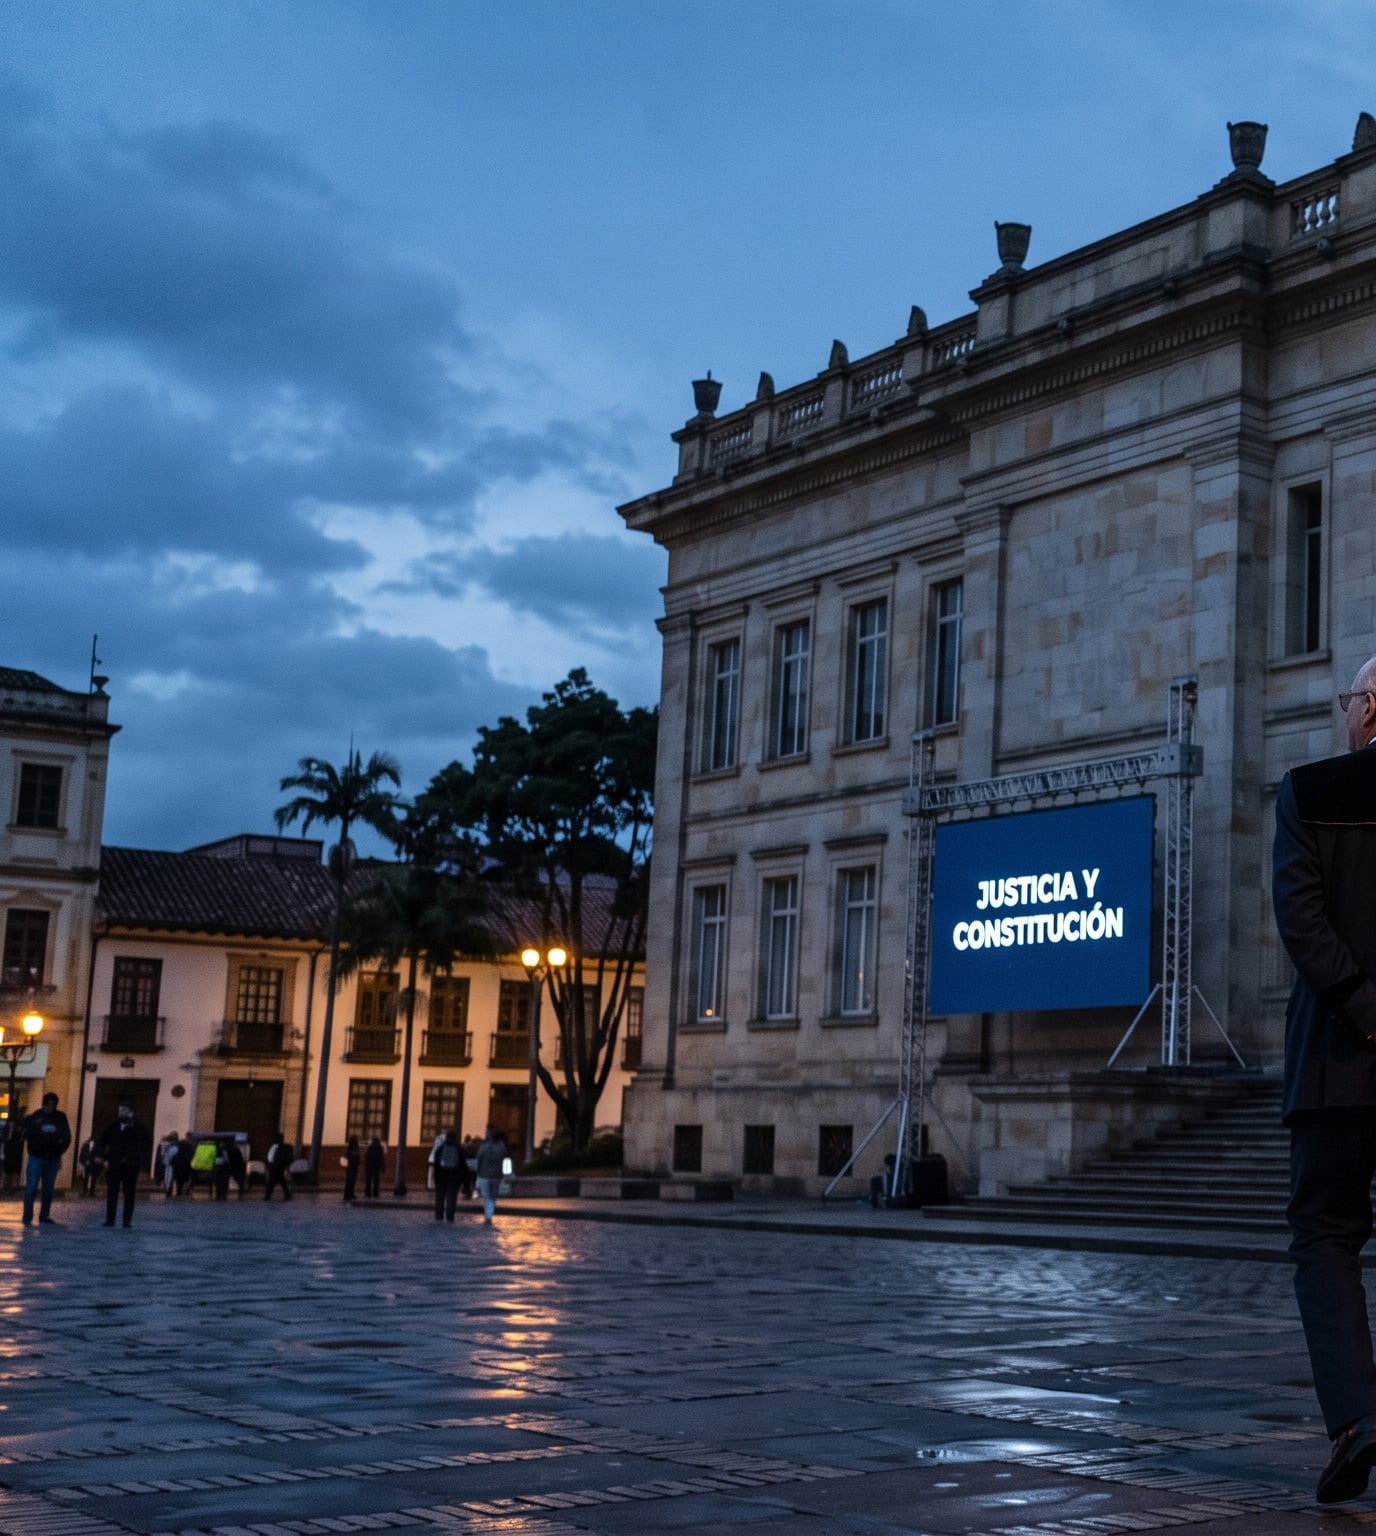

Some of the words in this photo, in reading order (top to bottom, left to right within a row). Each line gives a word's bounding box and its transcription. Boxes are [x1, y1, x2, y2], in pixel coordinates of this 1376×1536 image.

[976, 871, 1078, 910] JUSTICIA
[1082, 868, 1100, 898] Y
[952, 901, 1124, 951] CONSTITUCIÓN
